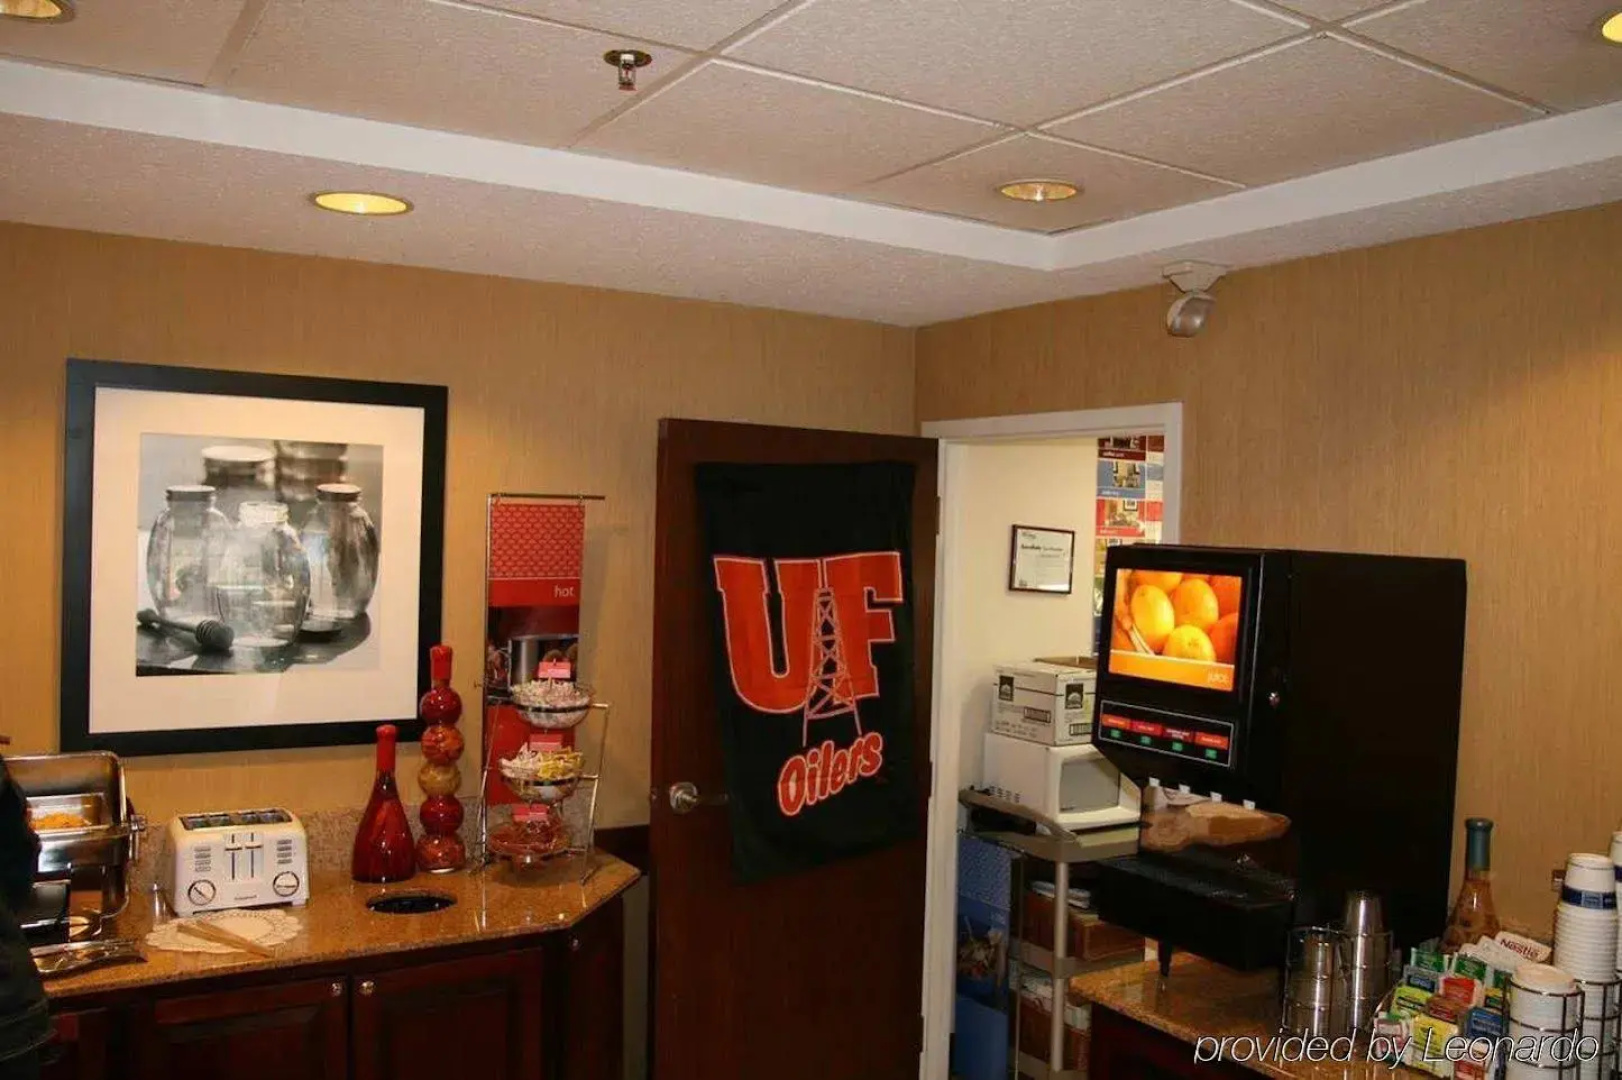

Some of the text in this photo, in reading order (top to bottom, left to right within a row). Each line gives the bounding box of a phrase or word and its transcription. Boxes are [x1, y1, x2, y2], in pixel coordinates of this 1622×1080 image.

[554, 584, 575, 598] hot
[713, 551, 903, 714] UF
[778, 732, 883, 816] Oilers
